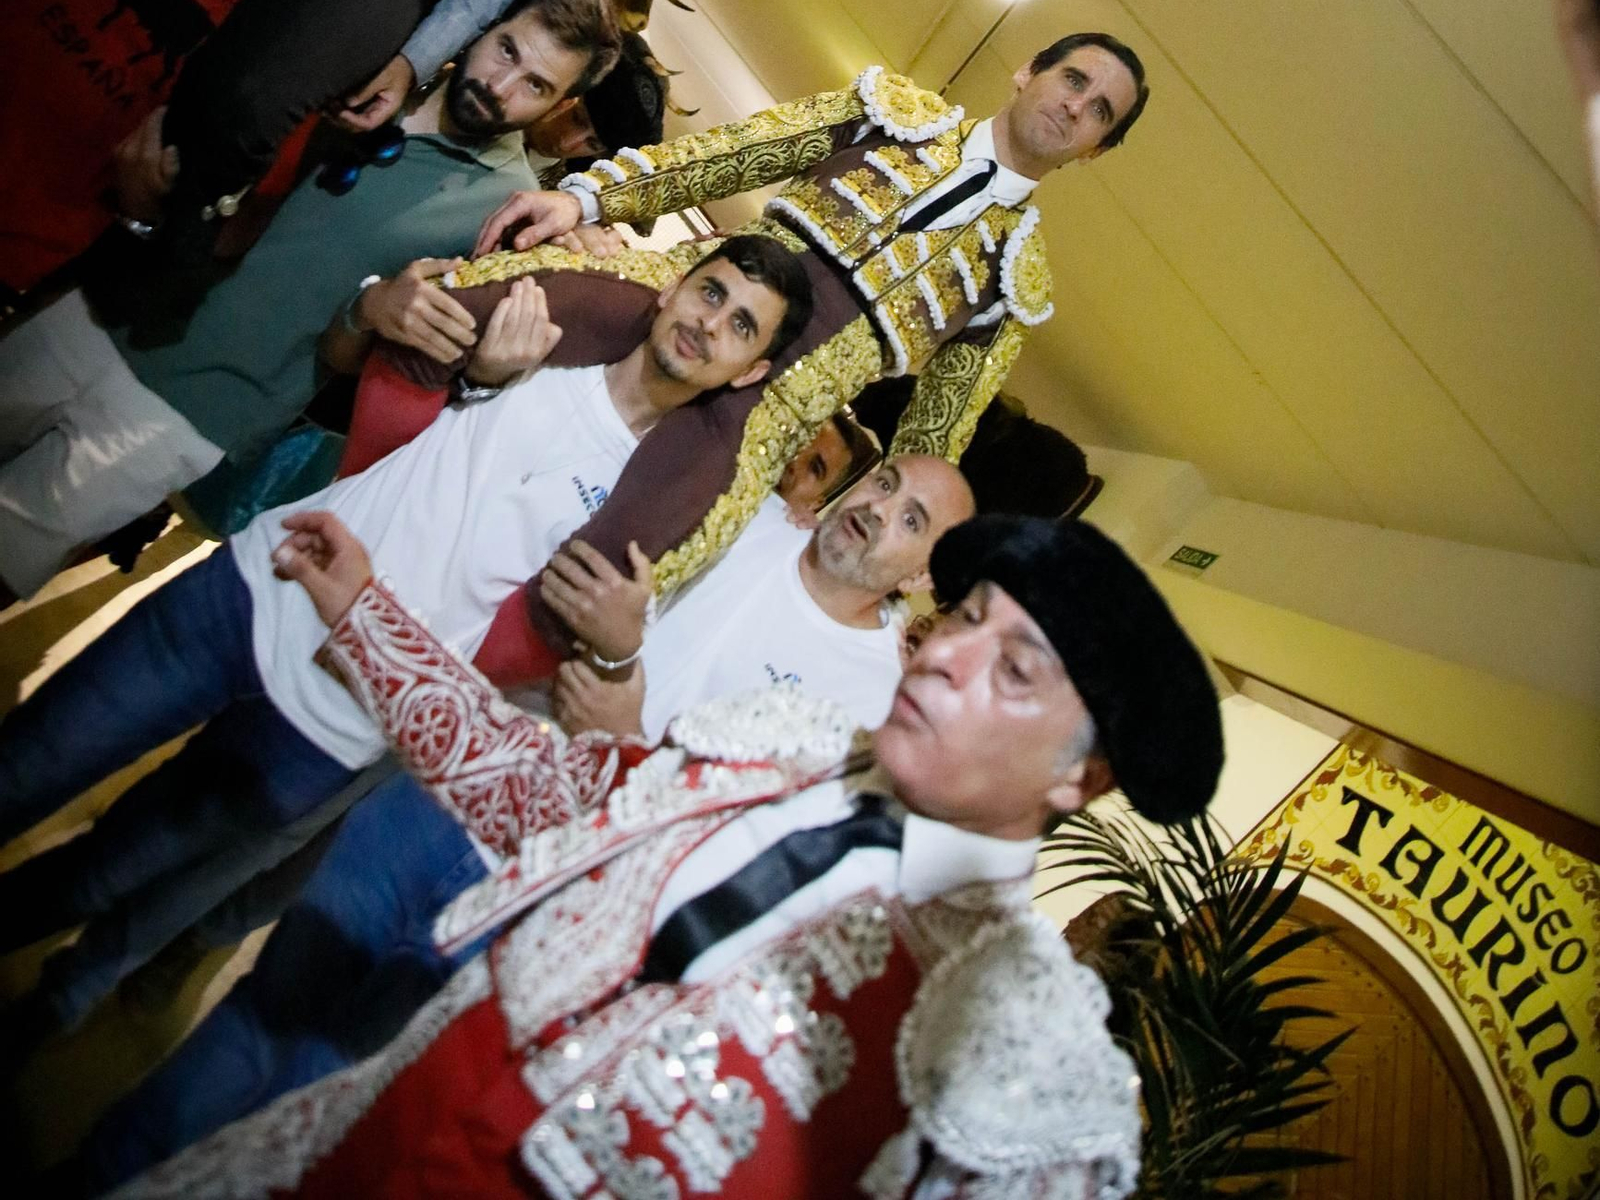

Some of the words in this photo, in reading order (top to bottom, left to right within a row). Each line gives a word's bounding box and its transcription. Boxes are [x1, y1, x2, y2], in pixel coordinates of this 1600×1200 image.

[38, 2, 136, 109] ESPAÑA
[572, 475, 596, 511] INSEC
[1335, 785, 1600, 1138] TAURINO
[1457, 815, 1588, 975] MUSEO
